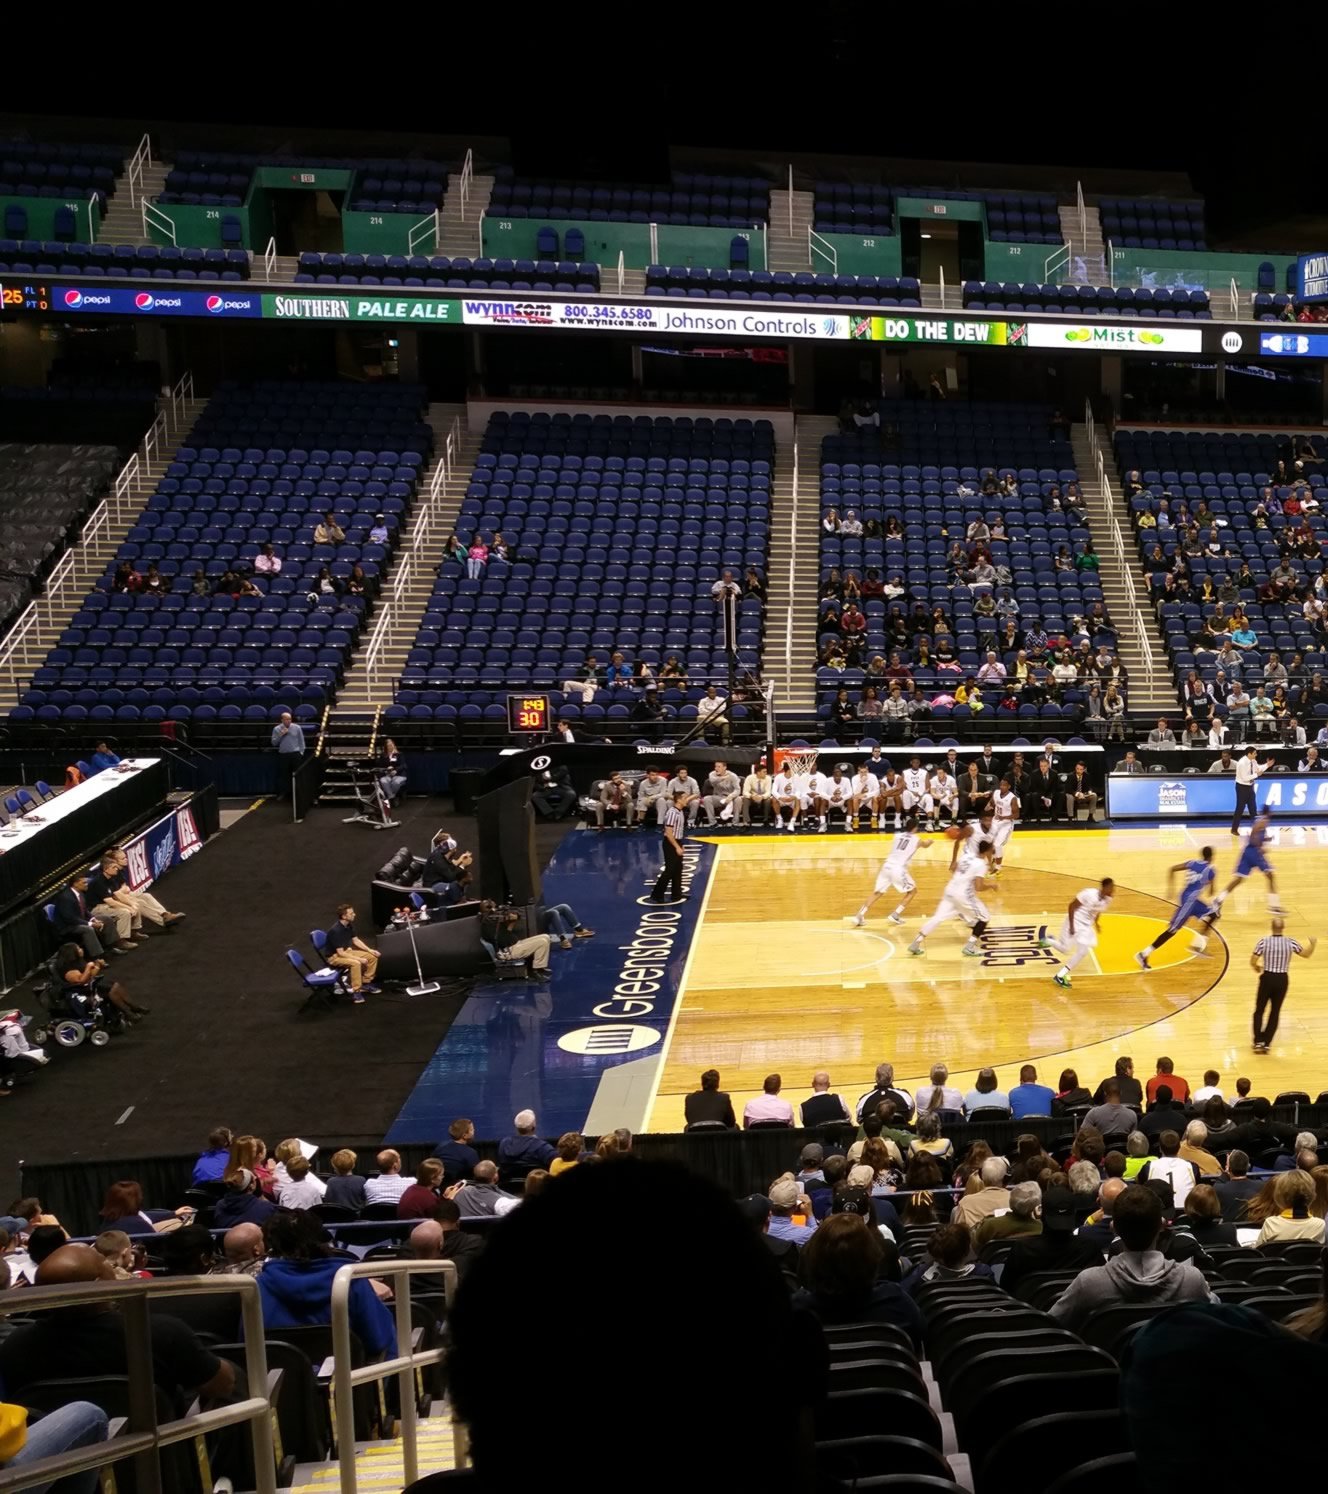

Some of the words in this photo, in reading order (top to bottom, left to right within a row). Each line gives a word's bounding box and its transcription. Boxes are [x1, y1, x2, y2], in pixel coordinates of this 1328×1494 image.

[206, 210, 219, 219] 214
[370, 217, 383, 225] 214
[863, 239, 875, 247] 212
[1009, 247, 1021, 255] 212
[1114, 251, 1125, 259] 211
[3, 289, 23, 304] 25
[25, 286, 36, 295] FL
[40, 287, 46, 296] 1
[26, 300, 38, 309] PT
[83, 295, 111, 306] pepsi
[154, 297, 182, 309] pepsi
[223, 299, 251, 310] pepsi
[275, 296, 350, 318] SOUTHERN
[357, 302, 408, 318] PALE
[410, 303, 448, 319] ALE
[465, 302, 552, 318] wynncom
[564, 305, 652, 319] 800.345.6580
[664, 312, 737, 332] Johnson
[743, 316, 816, 335] Controls
[885, 319, 909, 339] DO
[915, 321, 947, 340] THE
[953, 322, 989, 342] DEW
[1093, 327, 1136, 342] Mist
[523, 699, 545, 711] 1:43
[519, 711, 540, 726] 30
[637, 746, 675, 755] SPALDING
[896, 837, 910, 851] 10
[592, 911, 682, 1018] Greensboro
